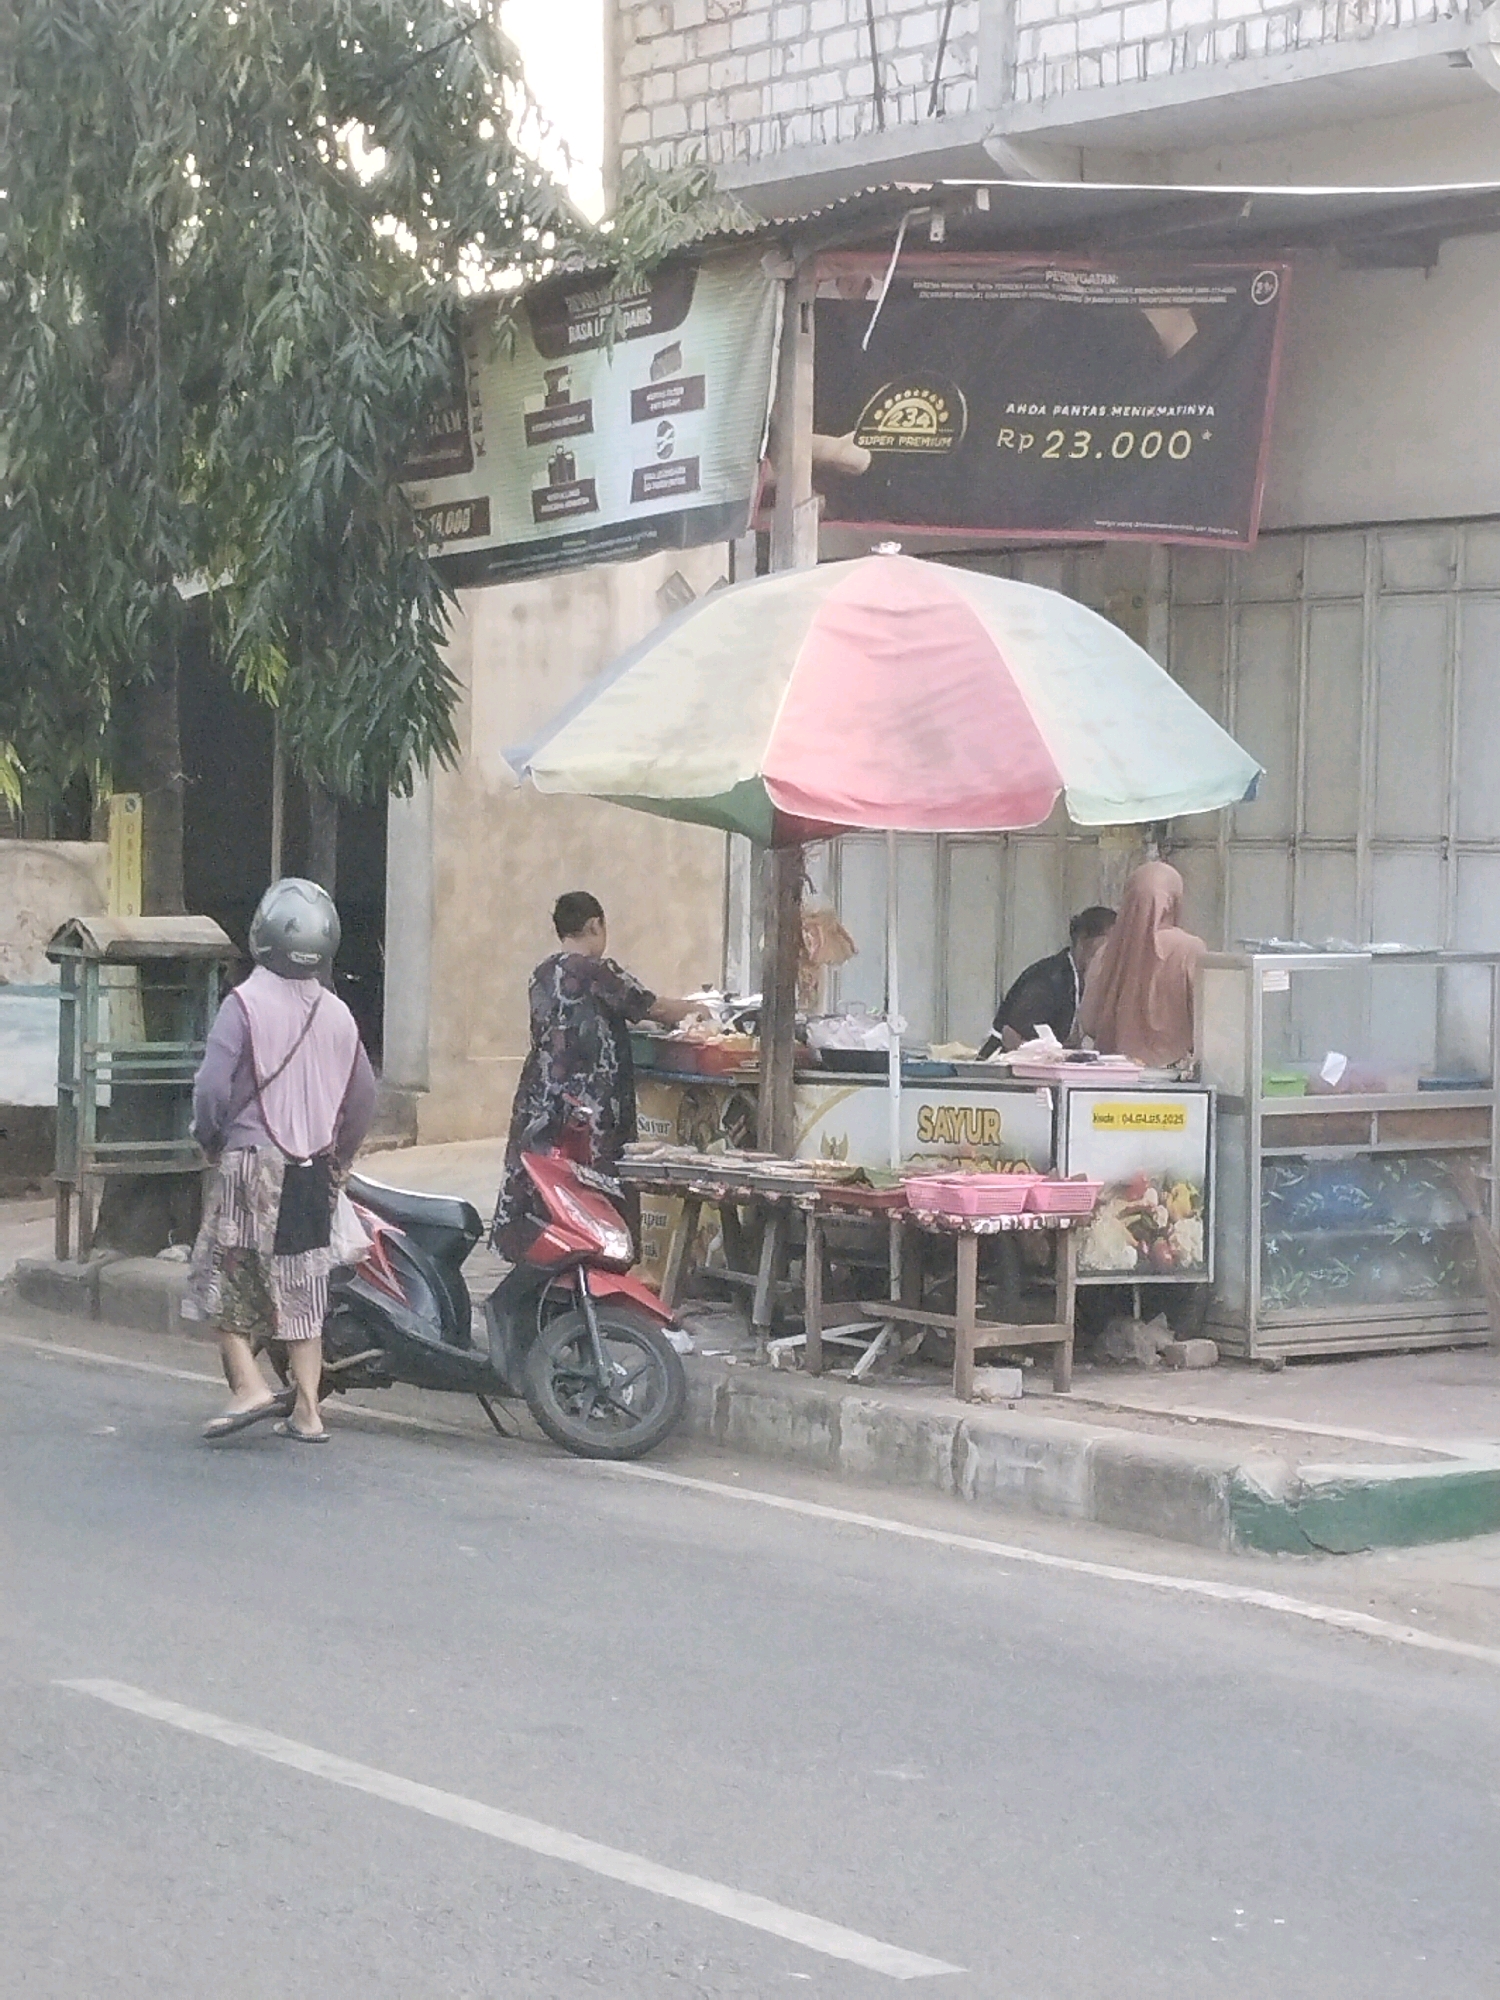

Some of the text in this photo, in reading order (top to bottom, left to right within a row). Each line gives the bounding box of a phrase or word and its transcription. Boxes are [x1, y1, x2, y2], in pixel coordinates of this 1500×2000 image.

[887, 407, 932, 429] 234
[1052, 404, 1106, 417] PANTAS
[857, 435, 953, 448] SUPER PREMIUM
[996, 427, 1035, 454] Rp
[637, 1113, 672, 1137] Sayur
[917, 1104, 1003, 1146] SAYUR
